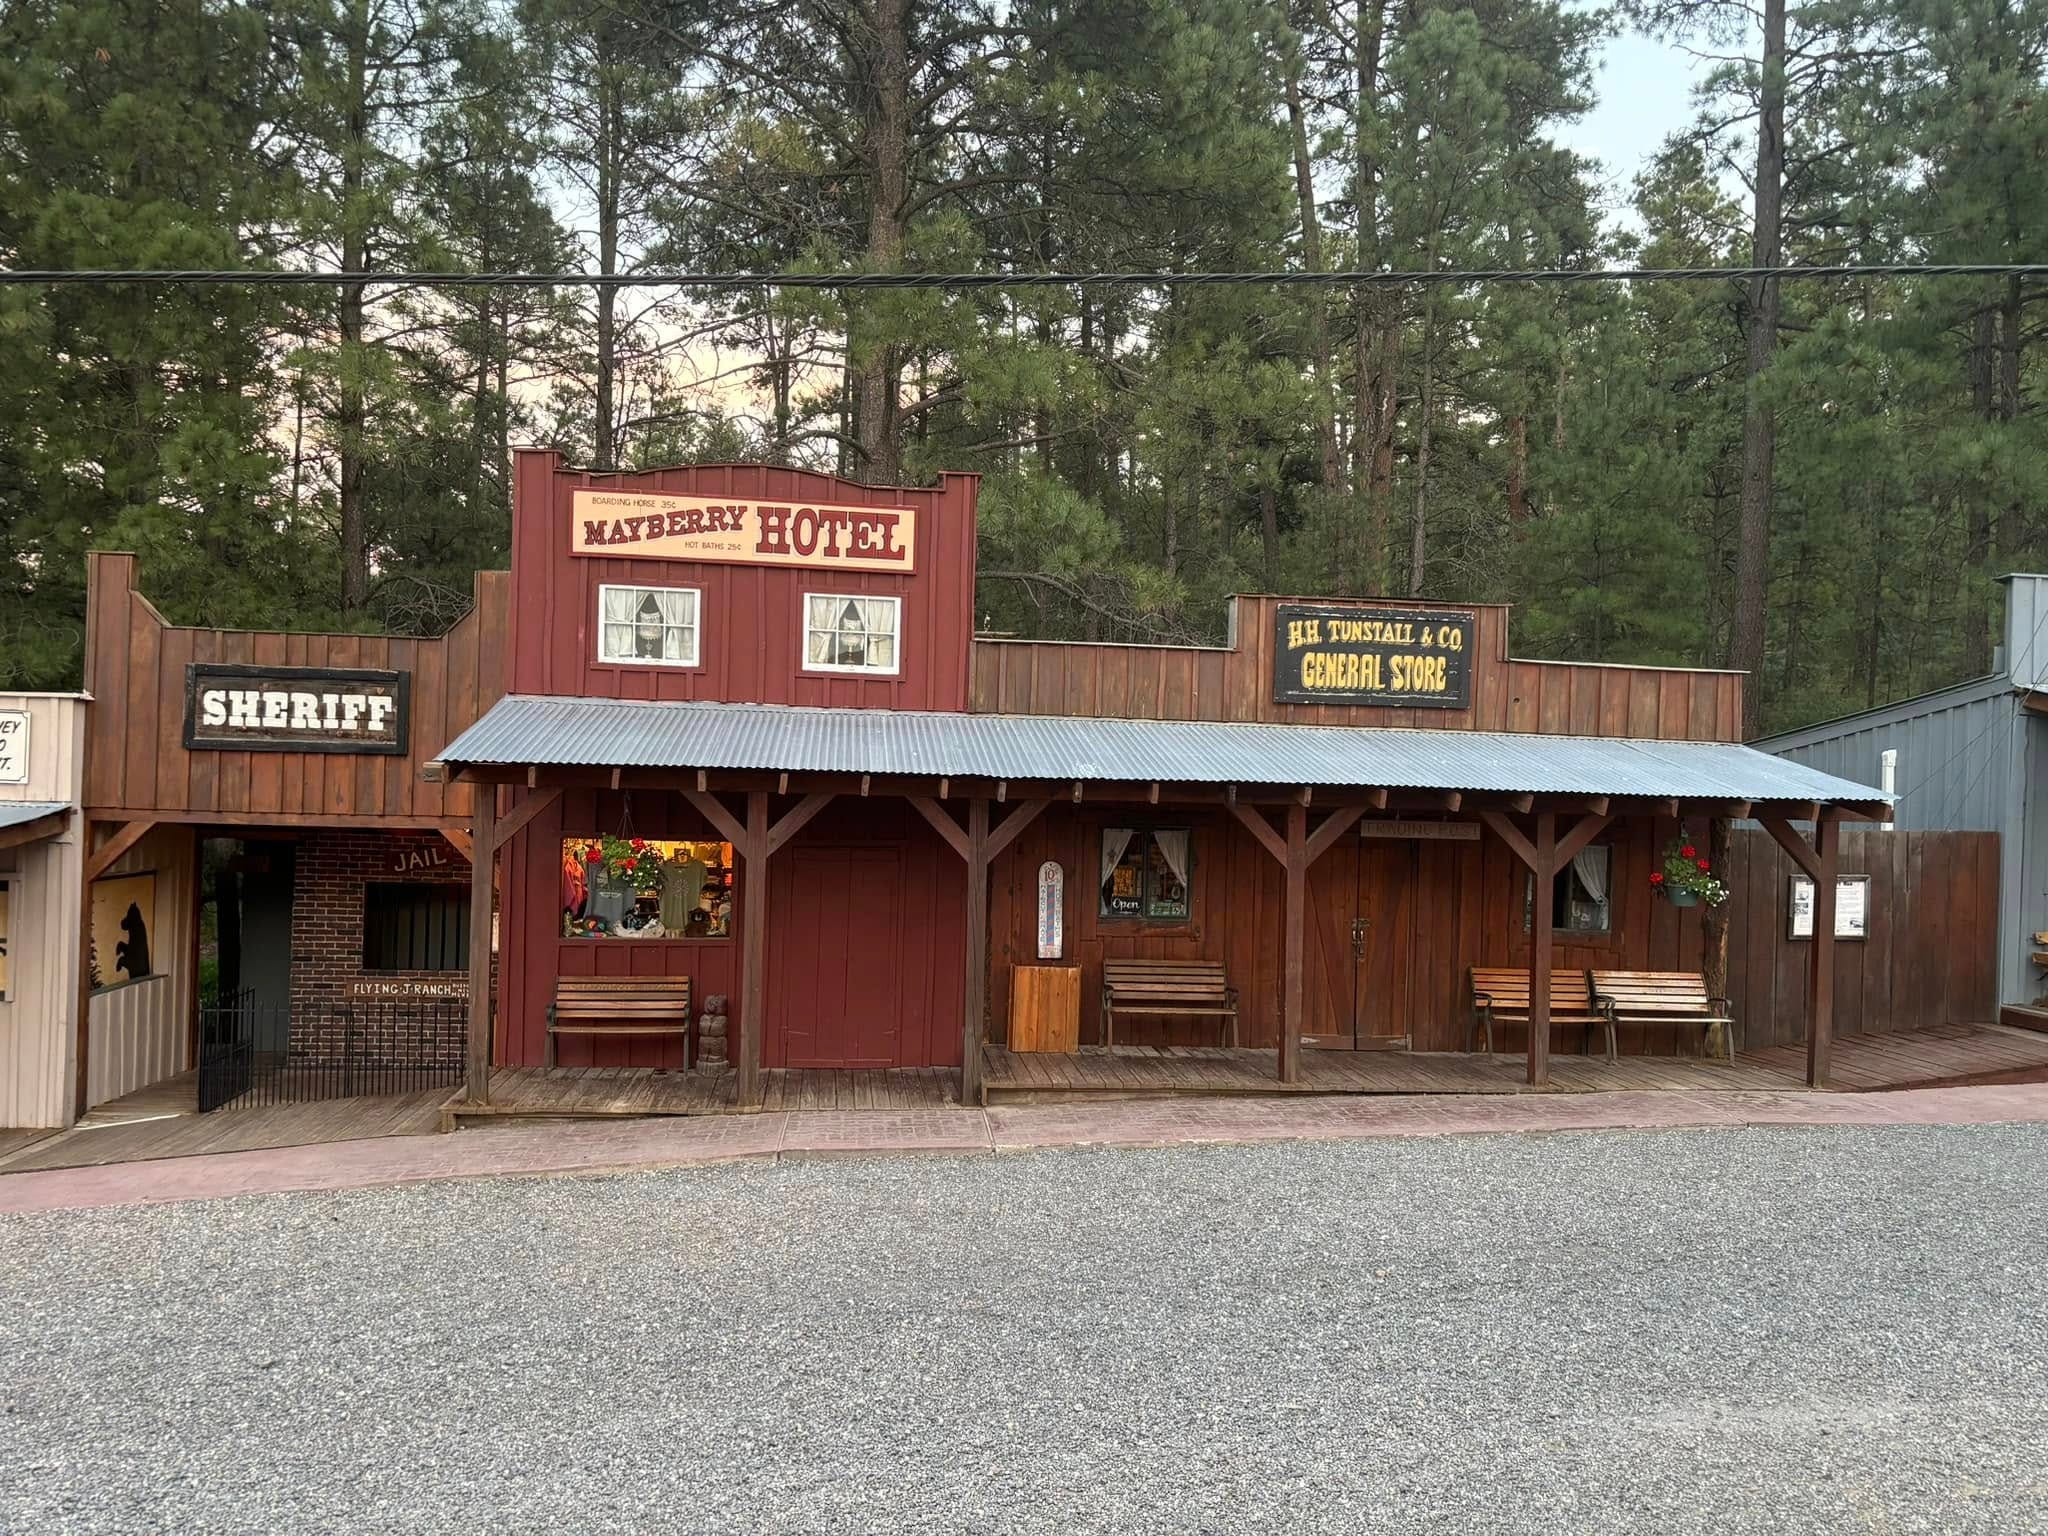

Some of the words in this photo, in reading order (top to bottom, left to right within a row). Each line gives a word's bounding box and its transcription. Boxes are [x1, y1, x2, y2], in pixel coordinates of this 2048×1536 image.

[592, 496, 631, 506] BOARDING
[584, 506, 748, 546] MAYBERRY
[756, 505, 906, 561] HOTEL
[684, 541, 698, 549] HOT
[702, 542, 724, 551] BATHS
[1327, 620, 1416, 645] TUNSTALL
[1421, 626, 1434, 648] &
[1302, 652, 1386, 690] GENERAL
[1389, 655, 1447, 692] STORE
[203, 689, 392, 731] SHERIFF
[394, 848, 447, 872] JAIL
[1112, 897, 1140, 912] Open
[353, 983, 399, 995] FLYING
[414, 983, 452, 995] RANCH
